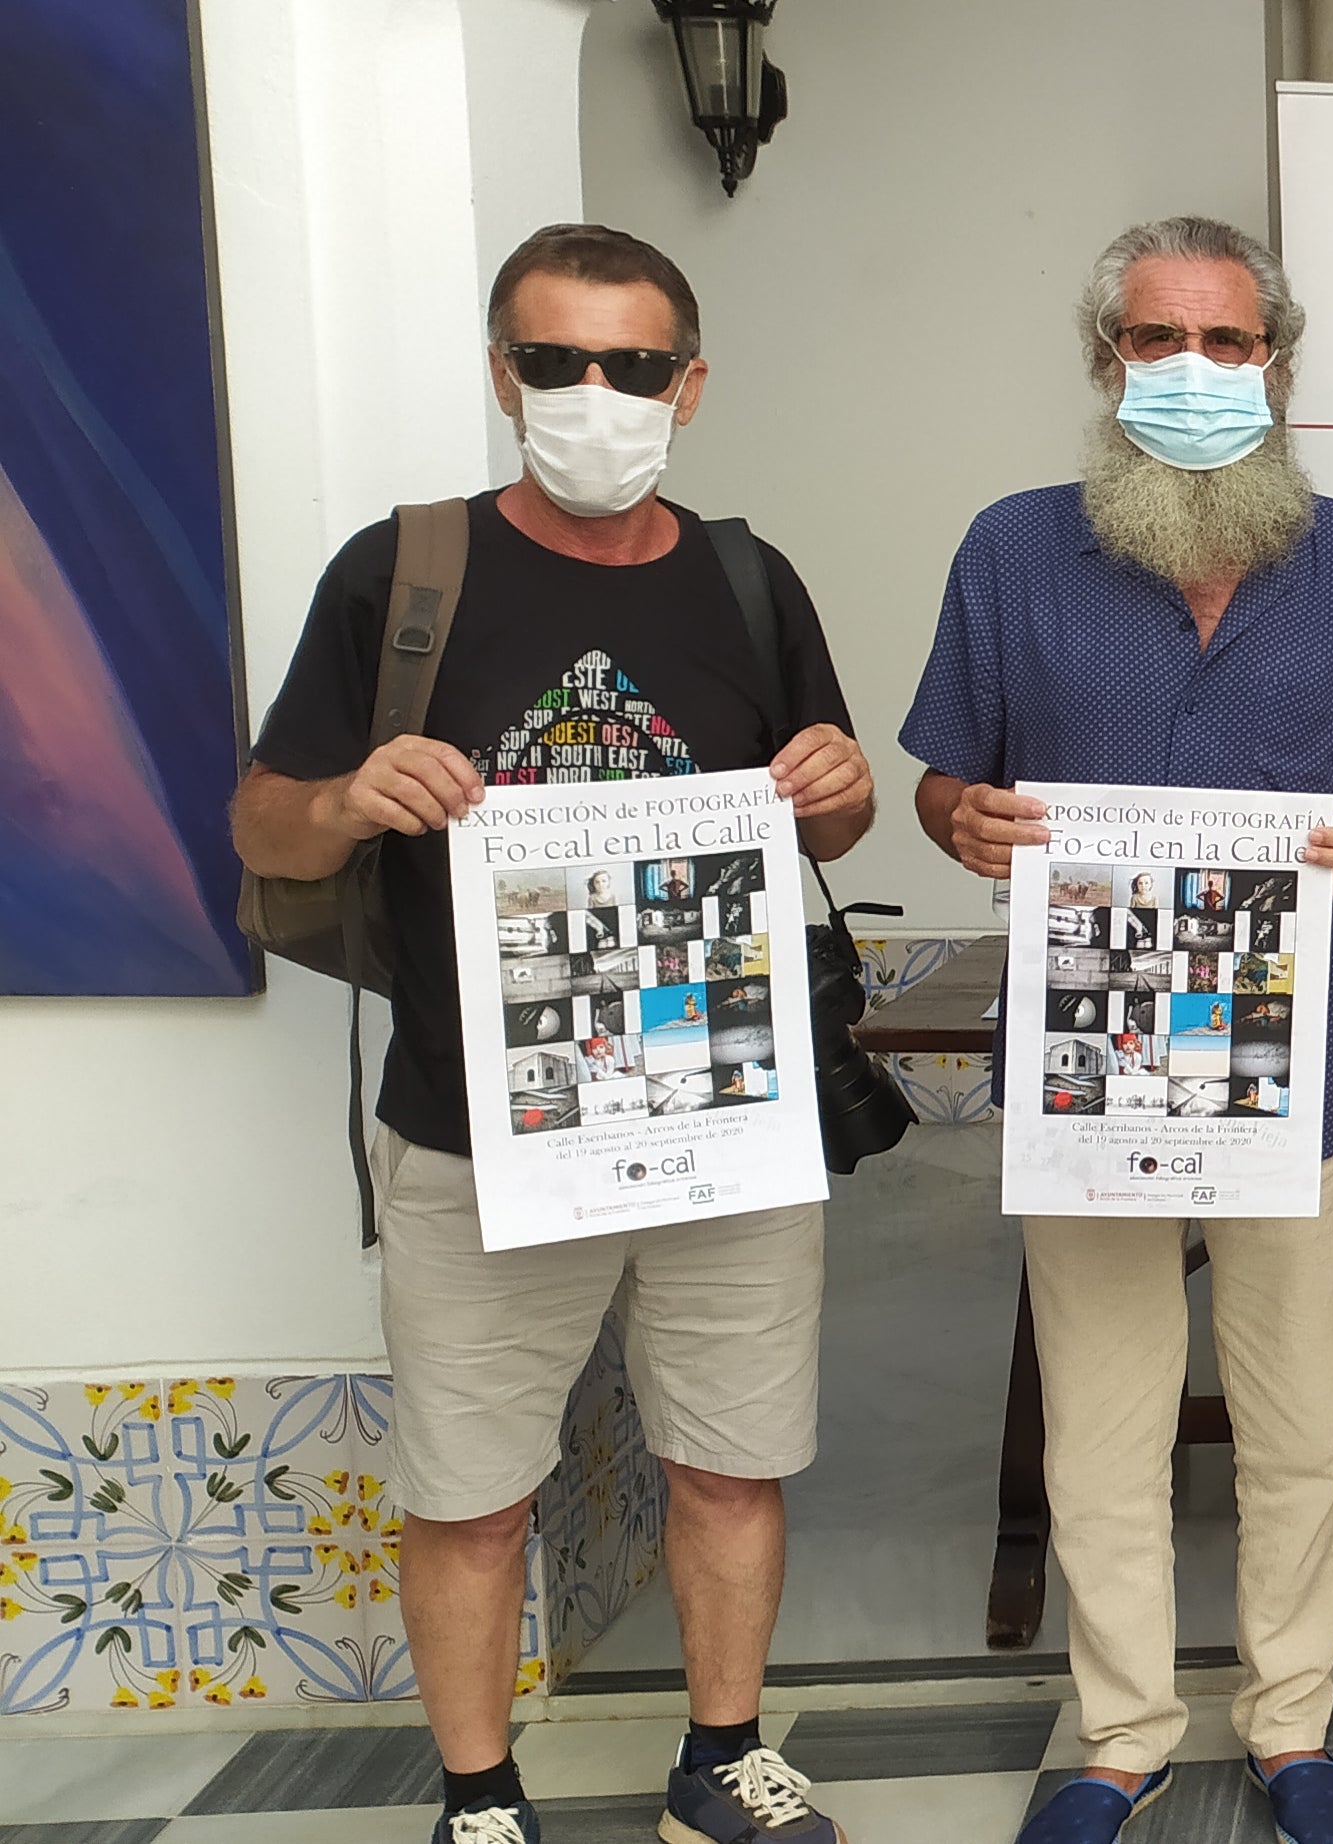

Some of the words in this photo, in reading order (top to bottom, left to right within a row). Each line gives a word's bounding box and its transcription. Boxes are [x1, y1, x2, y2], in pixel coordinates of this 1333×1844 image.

[578, 689, 618, 711] WEST
[551, 745, 602, 767] SOUTH
[608, 747, 649, 770] EAST
[616, 803, 637, 820] de
[646, 785, 784, 817] FOTOGRAFÍA
[1045, 804, 1156, 824] XPOSICIÓN
[1163, 808, 1184, 825] de
[1191, 810, 1326, 830] FOTOGRAFÍA
[482, 830, 593, 863] Fo-cal
[604, 832, 643, 855] en
[655, 823, 681, 851] la
[692, 814, 772, 846] Calle
[1044, 830, 1139, 858] Fo-cal
[1150, 840, 1184, 859] en
[1194, 833, 1221, 861] la
[1232, 836, 1308, 863] Calle
[547, 1136, 574, 1148] Calle
[645, 1124, 675, 1135] Arcos
[706, 1114, 749, 1126] Frontera
[1072, 1122, 1096, 1131] Calle
[1161, 1124, 1189, 1133] Arcos
[1191, 1125, 1203, 1133] de
[1206, 1125, 1214, 1133] la
[1218, 1124, 1257, 1134] Frontera
[1078, 1135, 1092, 1143] del
[1140, 1136, 1147, 1144] al
[688, 1188, 716, 1200] FAF
[1191, 1191, 1217, 1200] FAF
